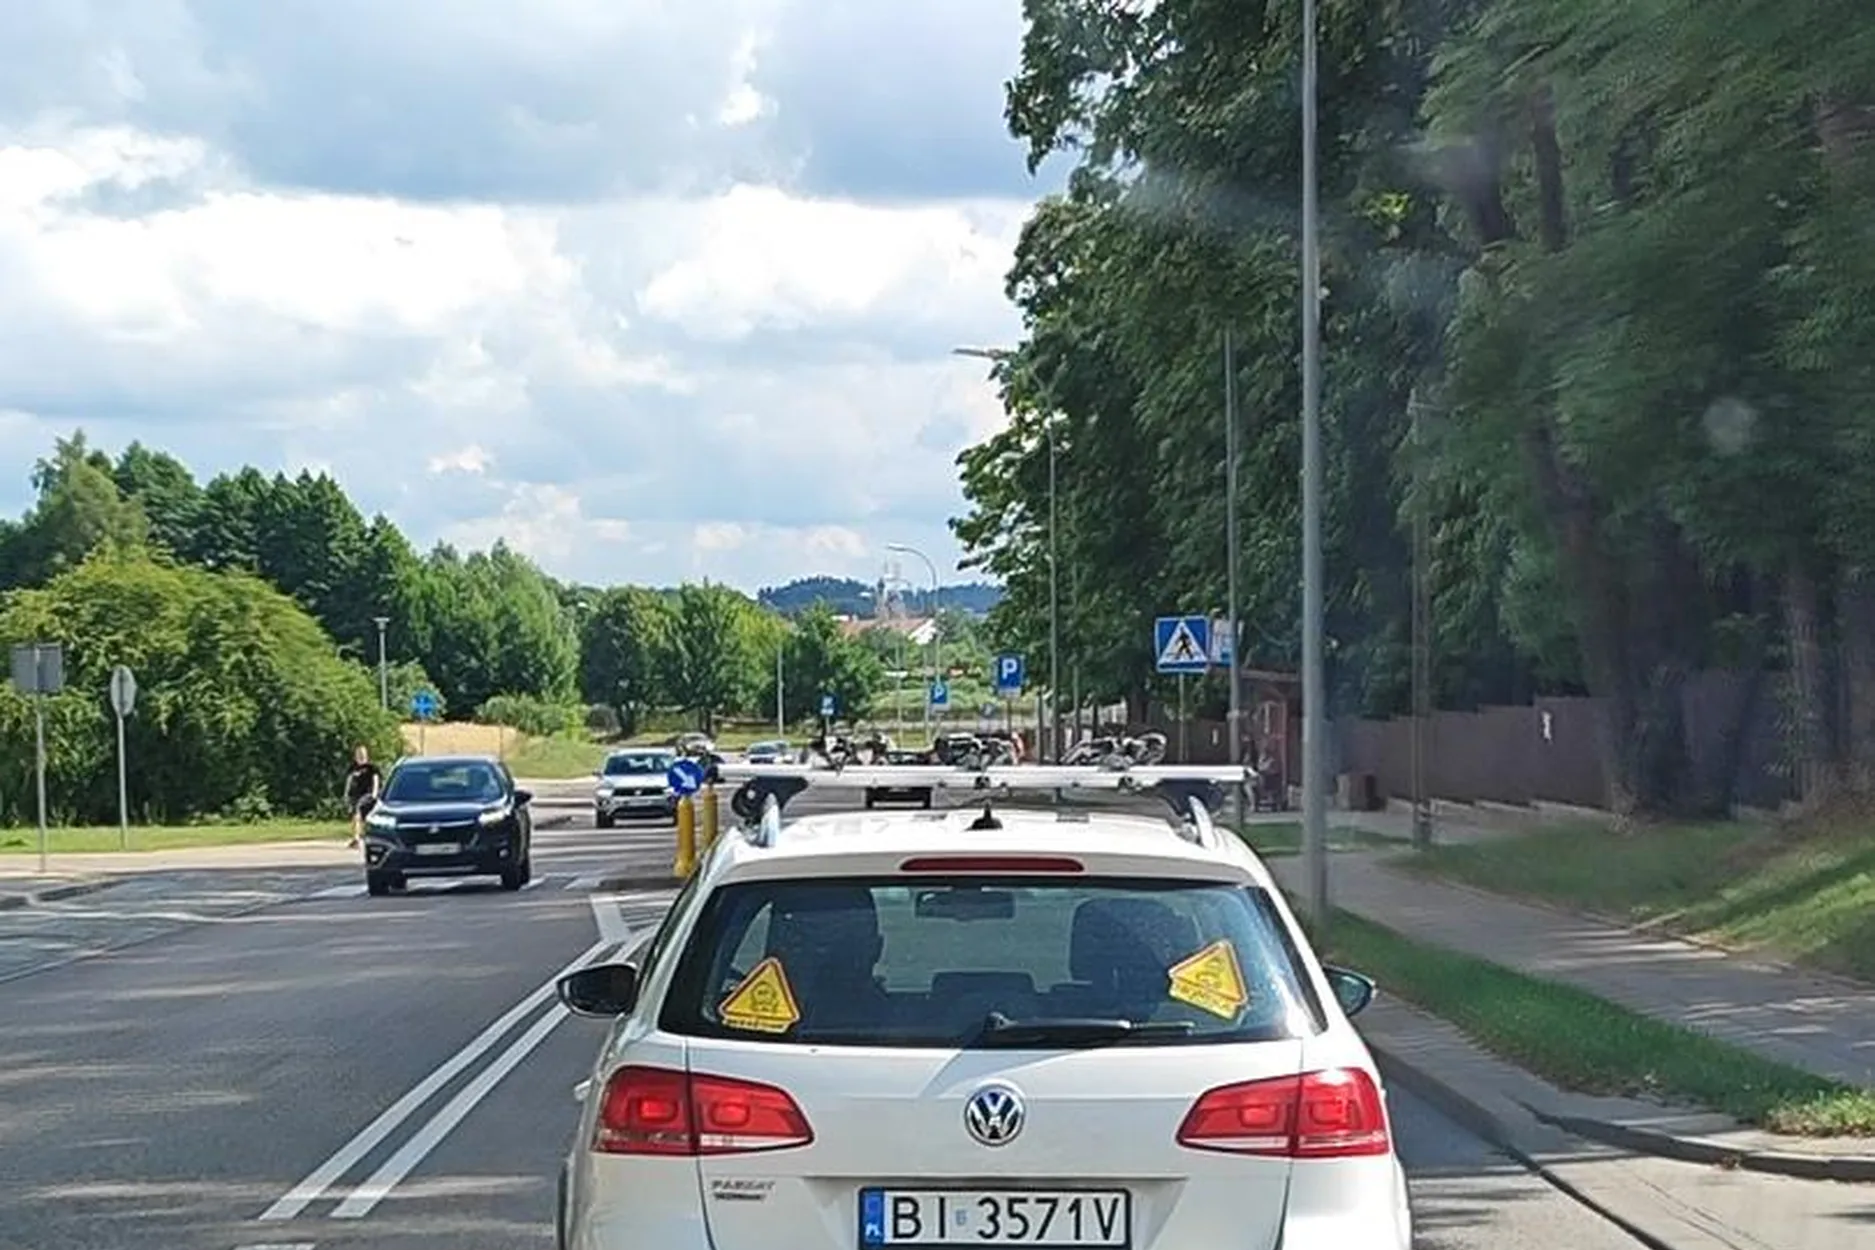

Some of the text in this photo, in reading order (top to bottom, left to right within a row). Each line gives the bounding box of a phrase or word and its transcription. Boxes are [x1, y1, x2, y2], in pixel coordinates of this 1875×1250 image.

[1002, 658, 1017, 680] P
[967, 1088, 1024, 1144] VW
[892, 1197, 1119, 1241] BI 3571V
